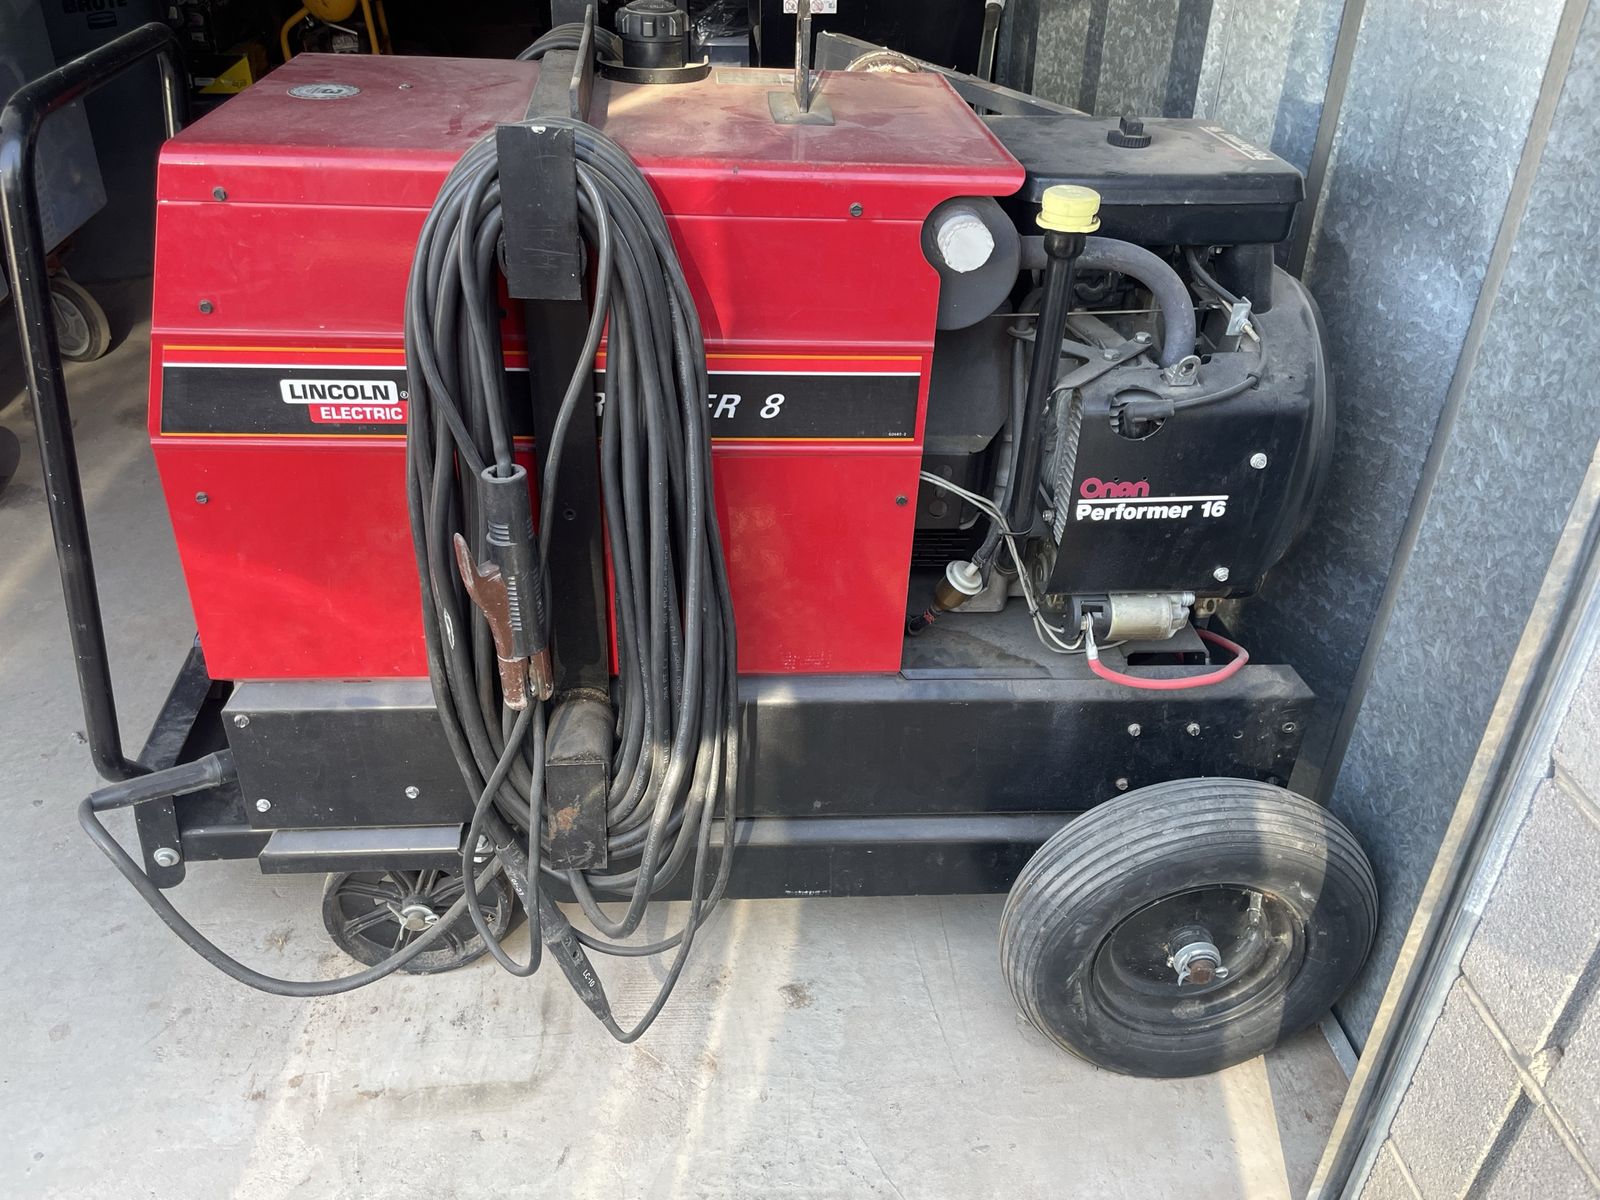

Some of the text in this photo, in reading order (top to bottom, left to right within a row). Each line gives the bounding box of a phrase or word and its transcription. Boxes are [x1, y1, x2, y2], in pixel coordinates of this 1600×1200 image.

[289, 384, 390, 400] LINCOLN
[320, 406, 403, 420] ELECTRIC
[760, 393, 785, 418] 8
[1080, 477, 1149, 499] Onan
[1076, 500, 1226, 521] Performer 16
[582, 969, 595, 988] LC-10
